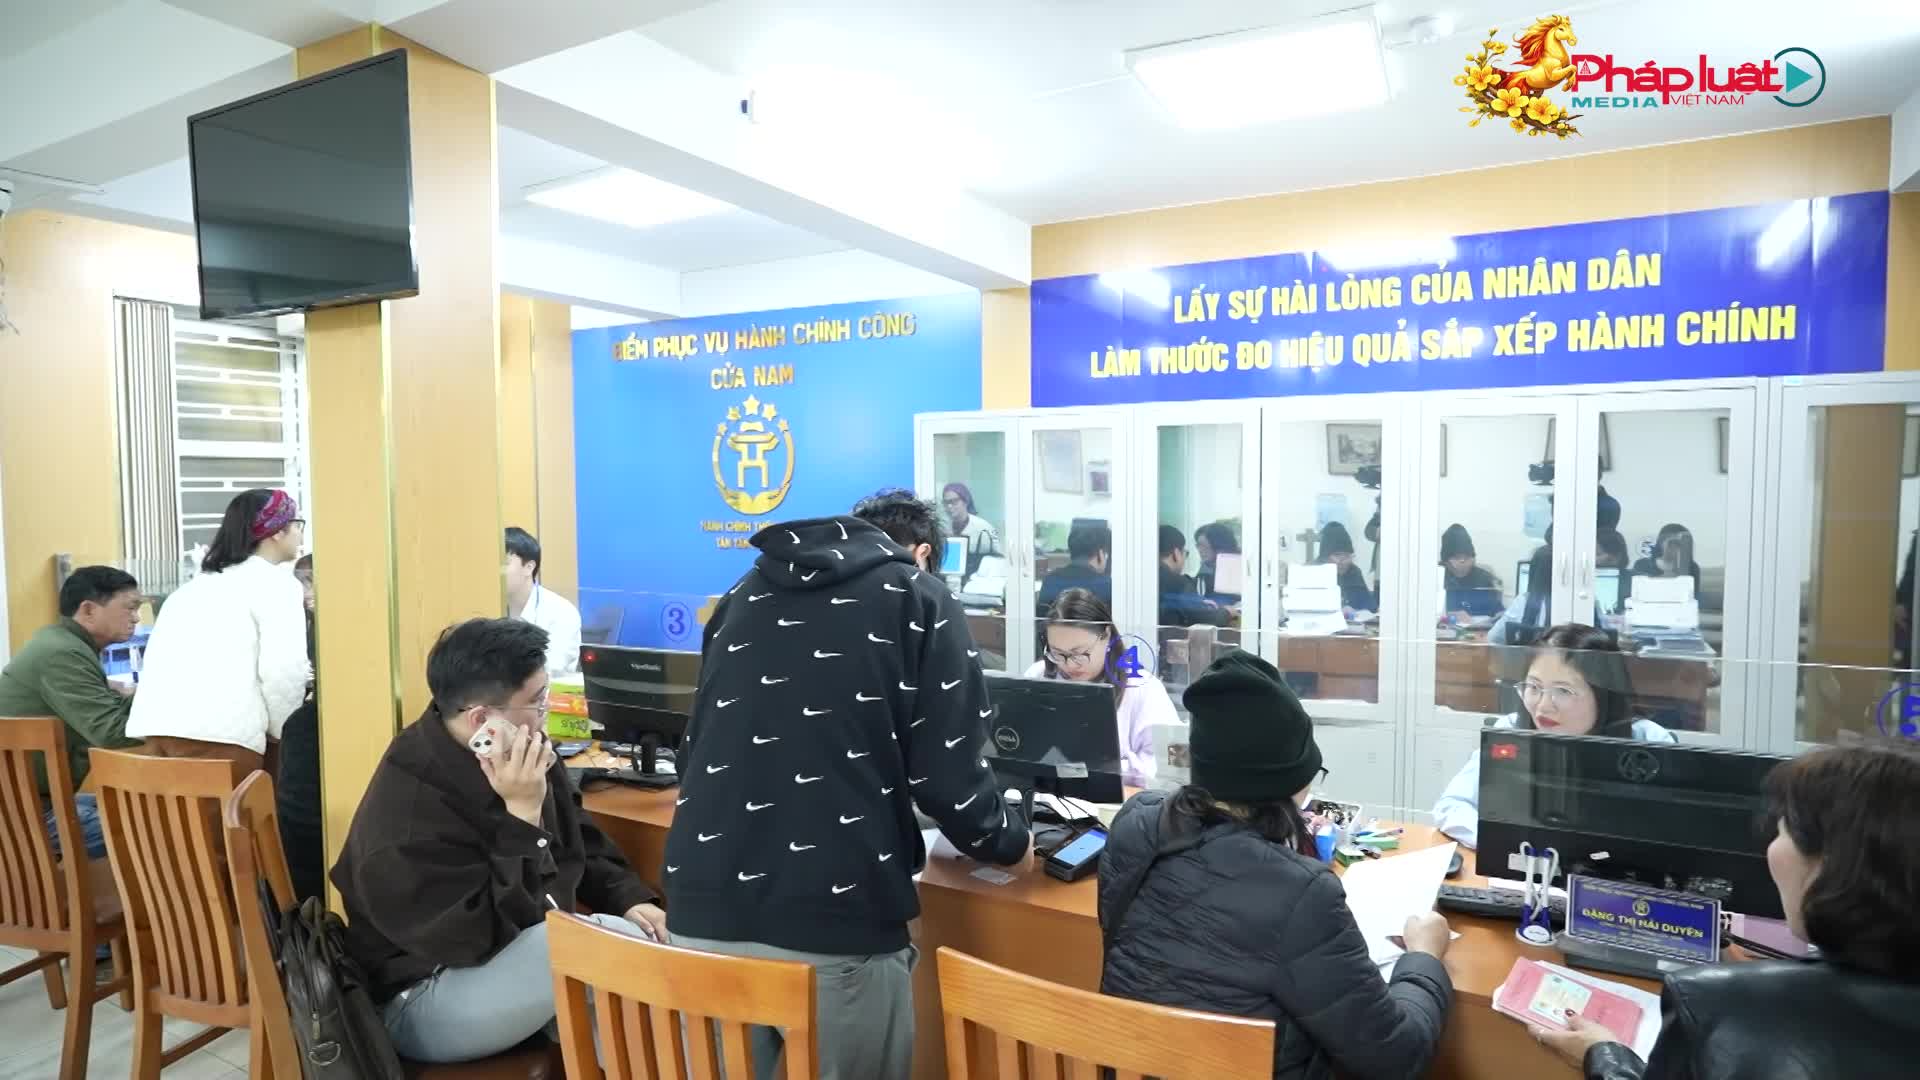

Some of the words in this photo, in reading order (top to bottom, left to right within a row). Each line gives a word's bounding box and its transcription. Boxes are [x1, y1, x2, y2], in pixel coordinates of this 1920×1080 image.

[1174, 283, 1221, 324] LẤY
[1228, 285, 1267, 324] SỰ
[1271, 279, 1317, 316] HÀI
[1325, 272, 1402, 312] LÒNG
[1410, 259, 1473, 305] CỦA
[1483, 257, 1576, 299] NHÂN
[1587, 249, 1661, 291] DÂN
[653, 334, 698, 361] PHỤC
[703, 331, 729, 356] VỤ
[735, 323, 786, 350] HÀNH
[793, 315, 850, 345] CHÍNH
[858, 311, 917, 339] CÔNG
[1090, 345, 1141, 378] LÀM
[1150, 335, 1229, 375] THƯỚC
[1236, 340, 1272, 370] ĐO
[1279, 331, 1344, 373] HIỆU
[1352, 318, 1412, 367] QUẢ
[1420, 317, 1484, 360] SẮP
[1493, 311, 1558, 356] XẾP
[1568, 311, 1665, 352] HÀNH
[1676, 300, 1796, 346] CHÍNH
[754, 364, 794, 387] NAM
[669, 608, 685, 635] 3
[1116, 645, 1144, 678] 4
